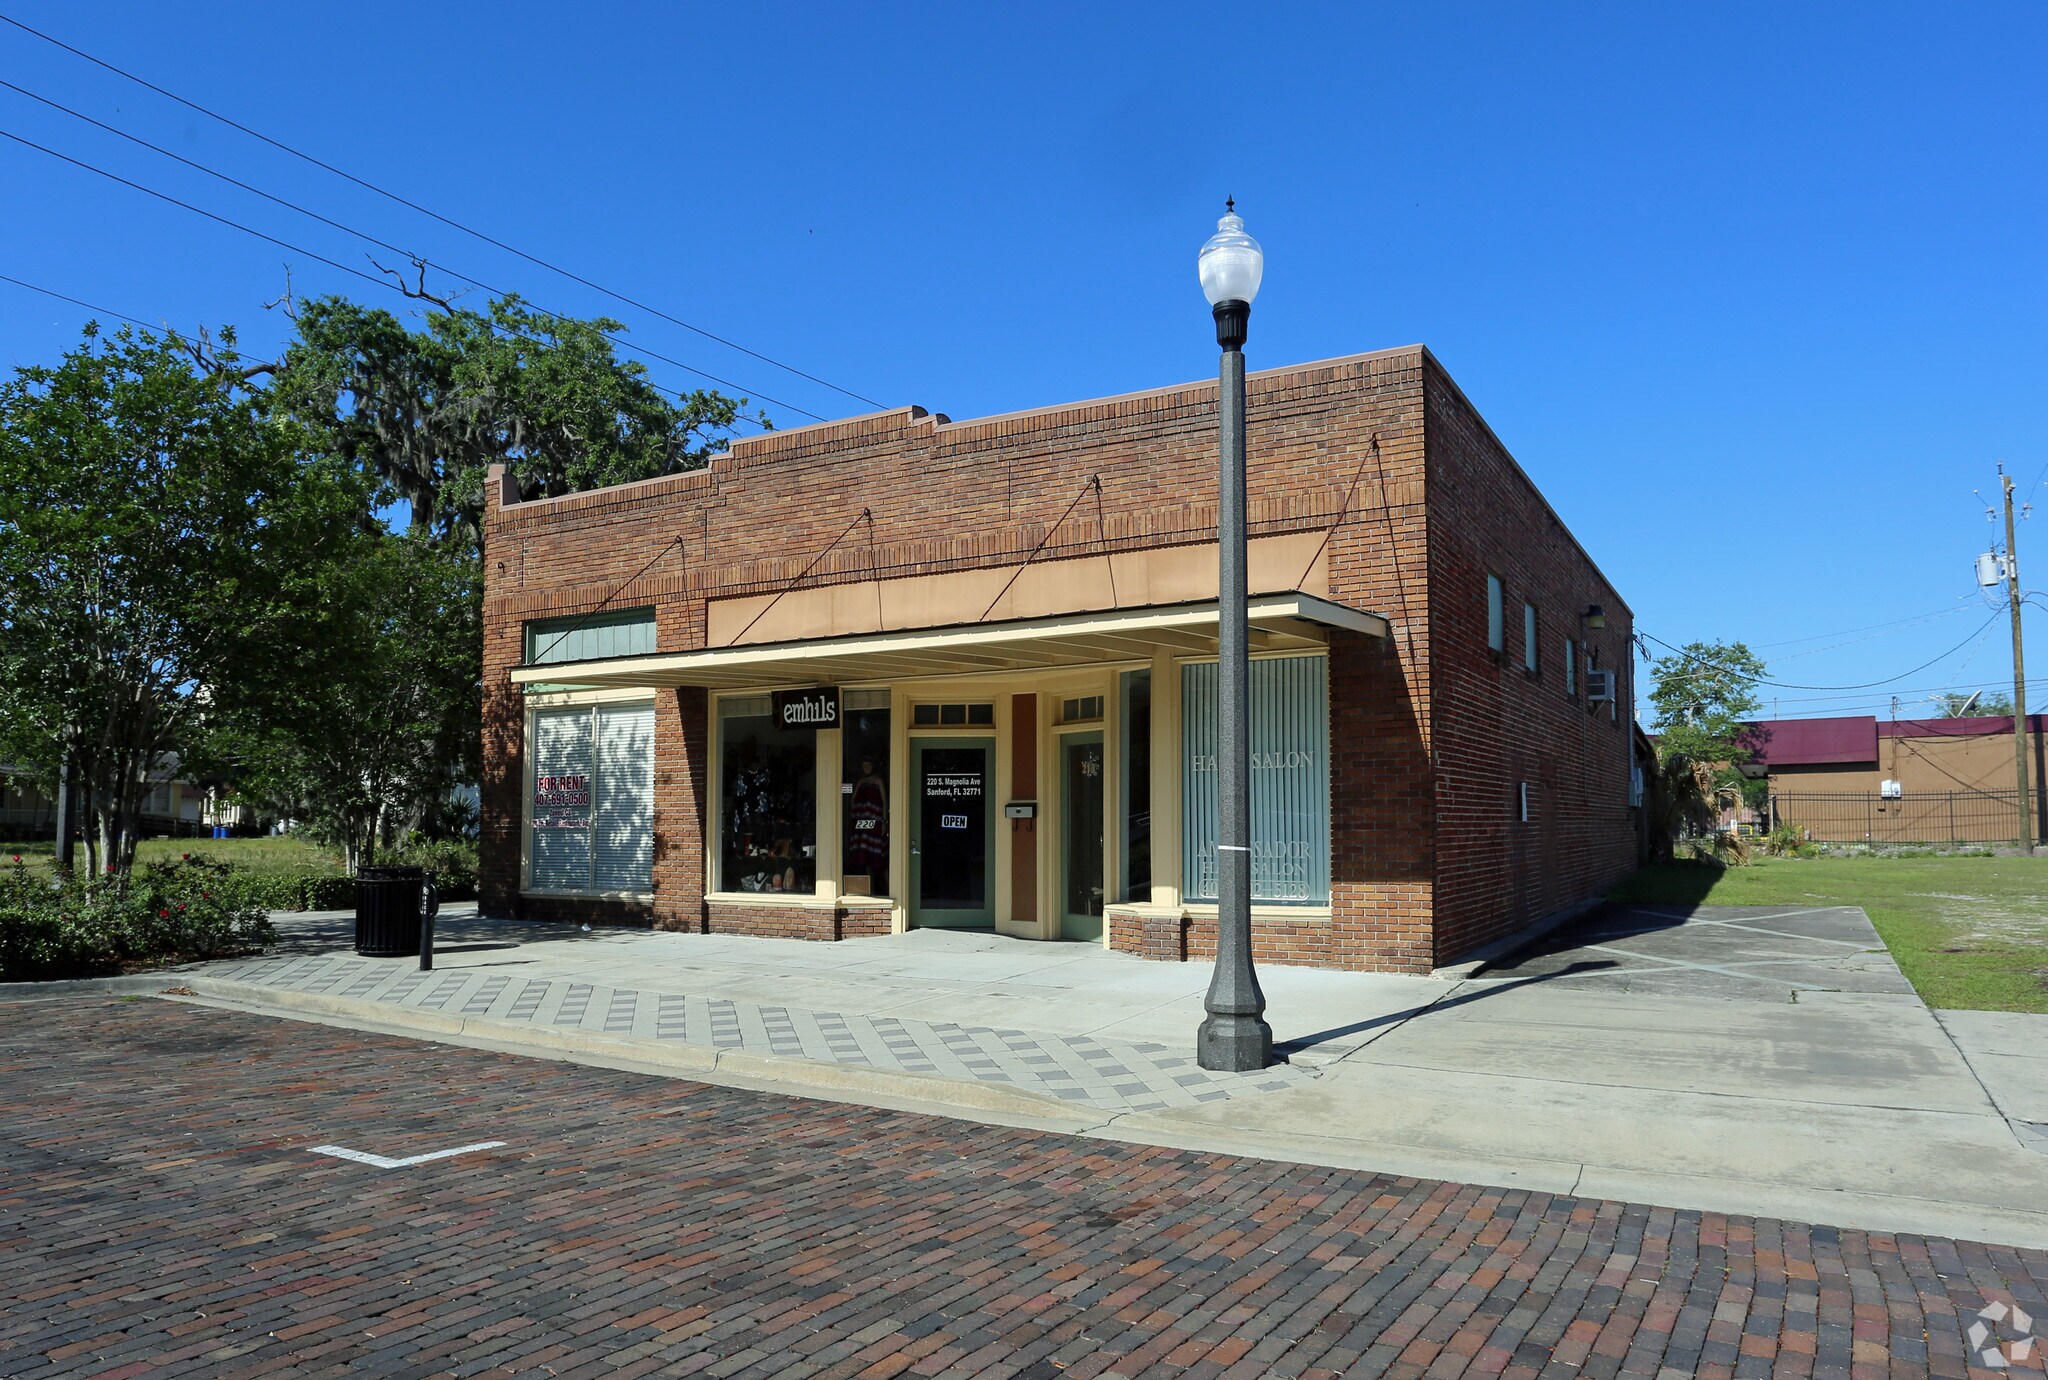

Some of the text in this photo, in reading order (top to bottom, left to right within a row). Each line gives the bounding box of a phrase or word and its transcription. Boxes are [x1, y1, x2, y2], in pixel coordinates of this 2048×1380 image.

[1192, 751, 1314, 771] HA SALON
[538, 776, 585, 791] FOR RENT
[945, 778, 969, 787] Magnolia
[927, 788, 952, 797] Sanford,
[534, 792, 588, 806] 407-691-0500
[857, 820, 875, 828] 220
[943, 816, 966, 827] OPEN
[1251, 862, 1307, 875] SALON
